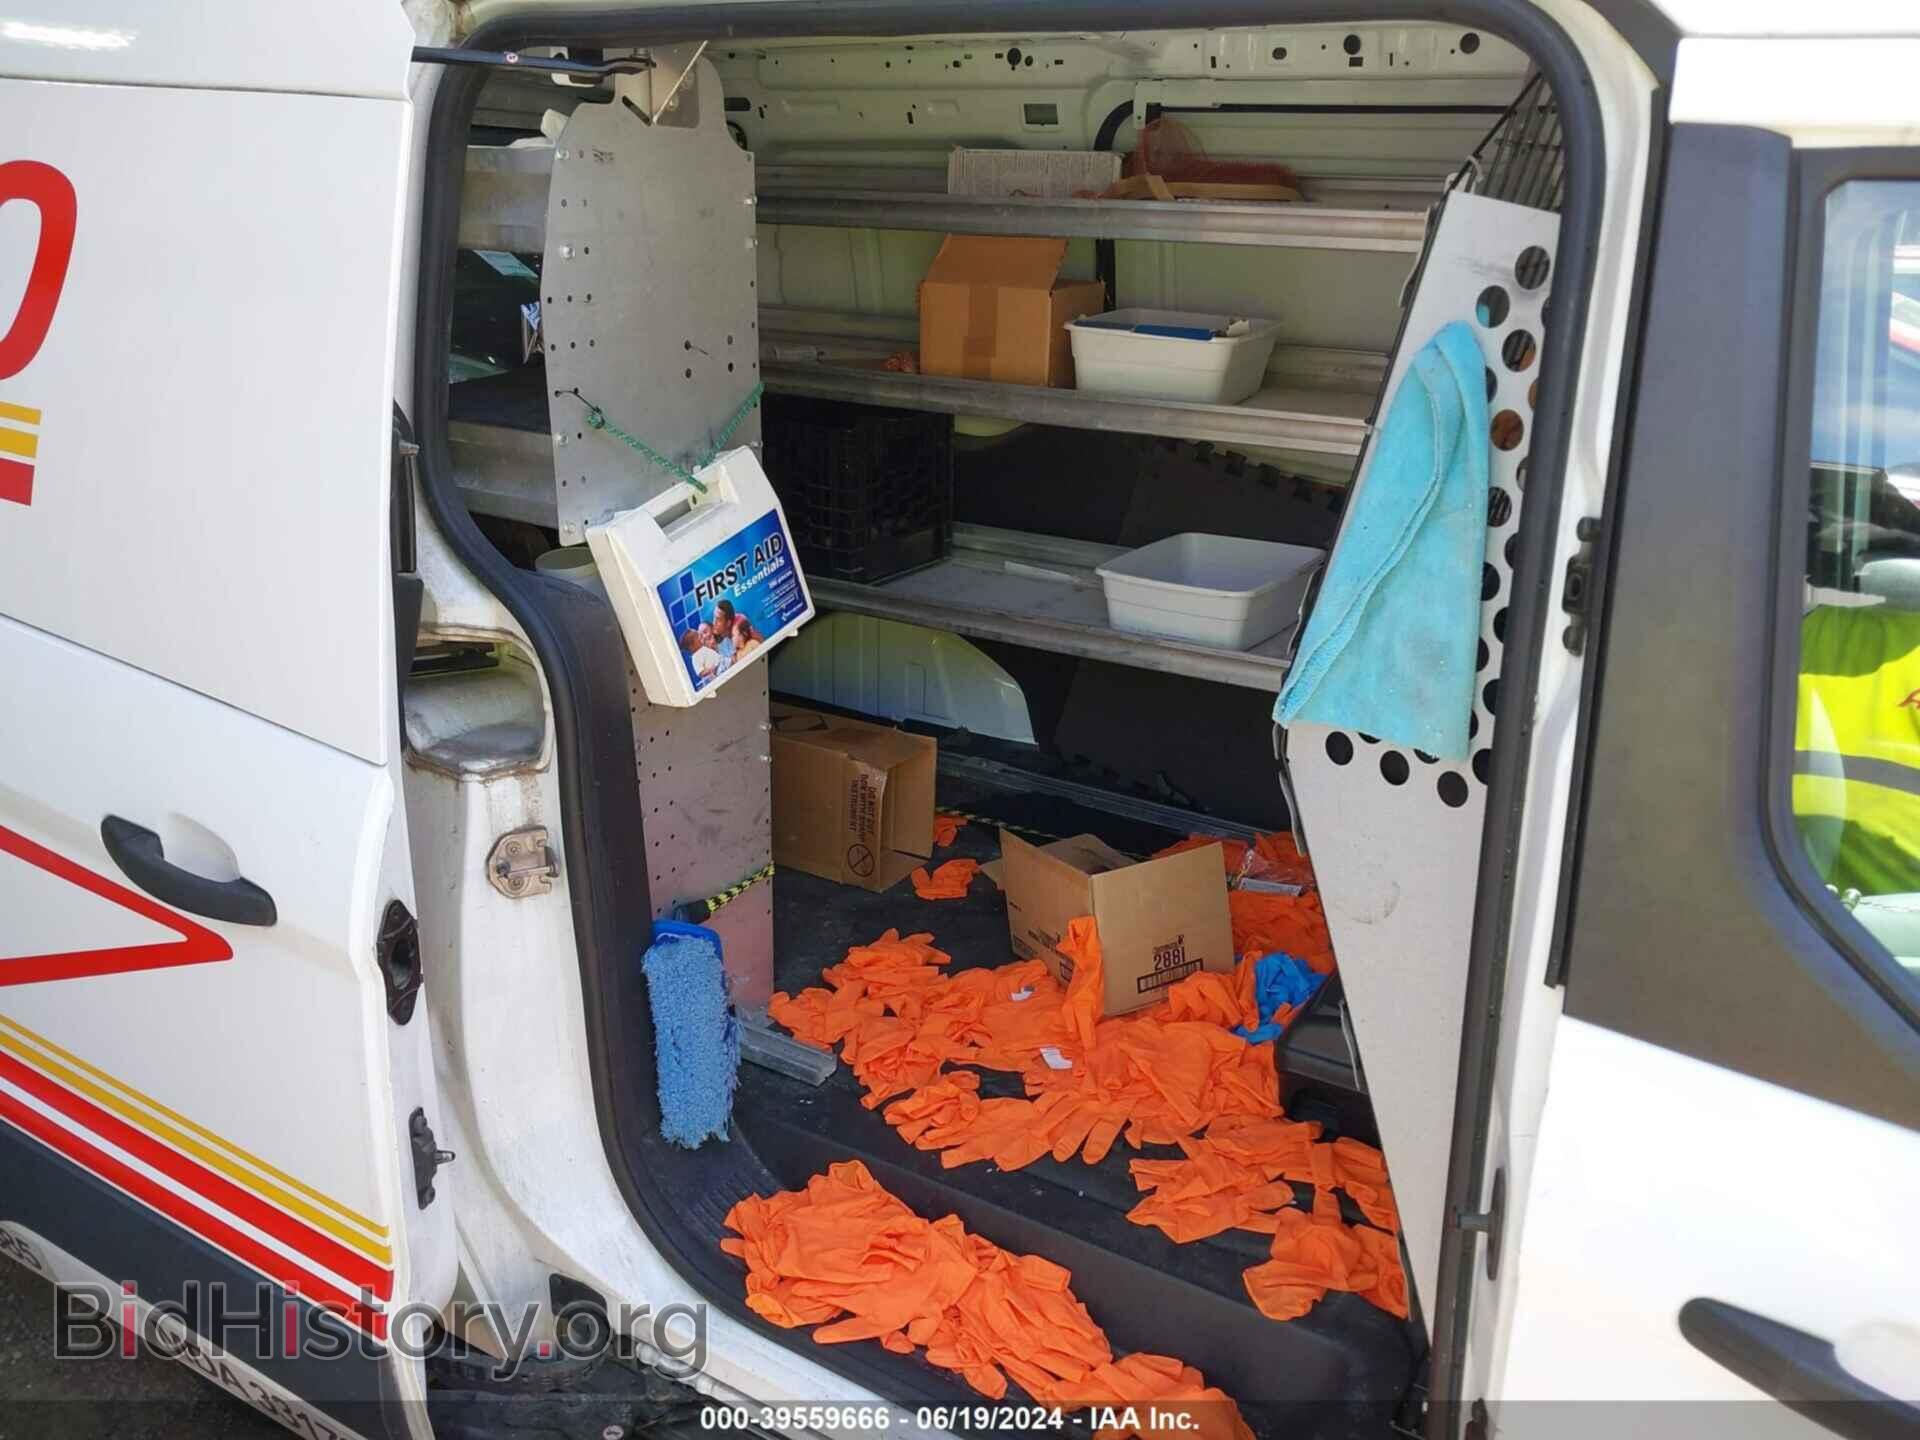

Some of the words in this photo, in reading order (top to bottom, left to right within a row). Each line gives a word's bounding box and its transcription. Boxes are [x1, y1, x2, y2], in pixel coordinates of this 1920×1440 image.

[695, 553, 748, 608] FIRST
[754, 533, 784, 570] AID
[733, 556, 785, 597] Essentials
